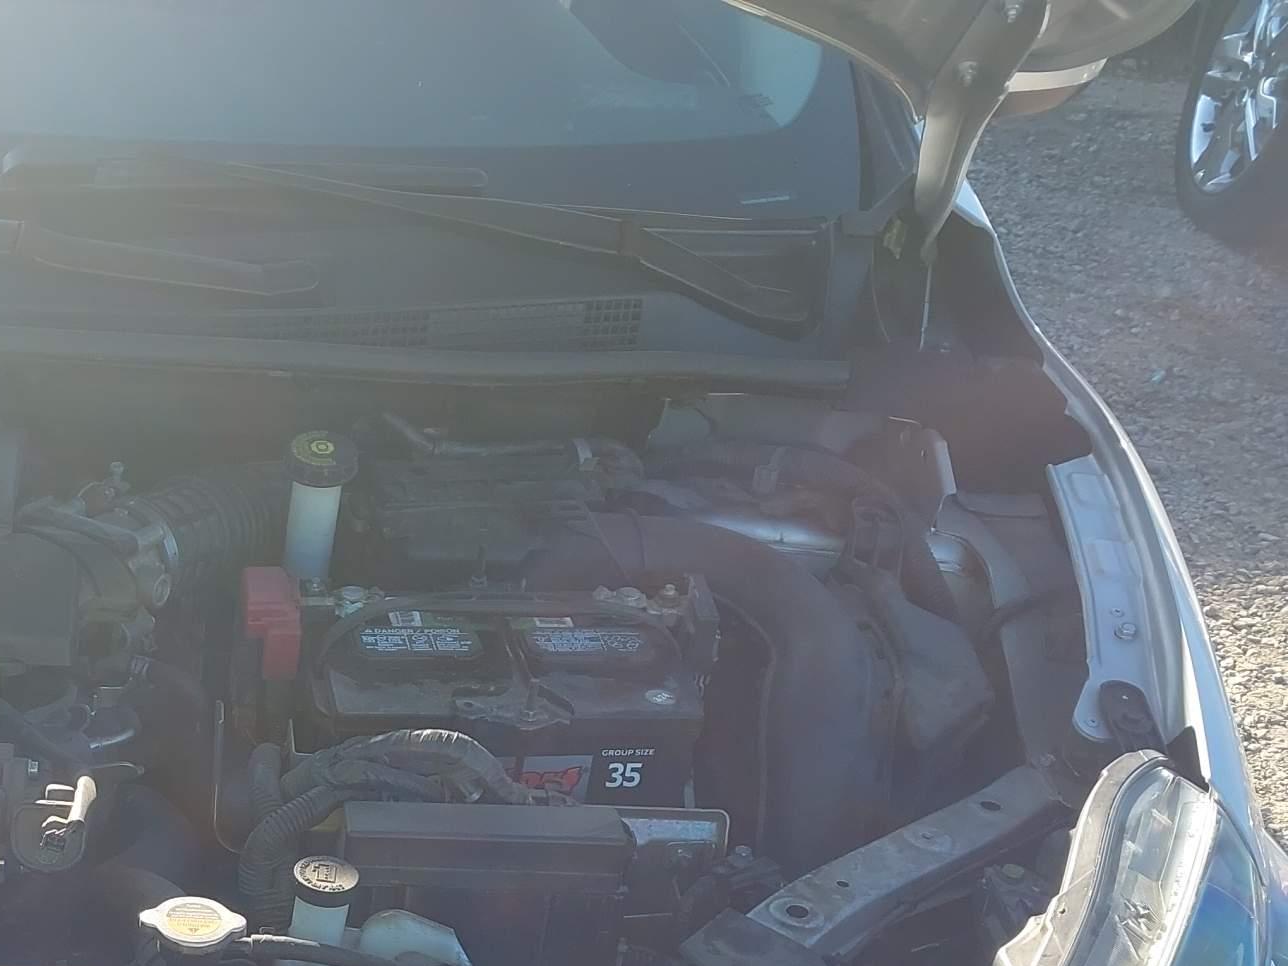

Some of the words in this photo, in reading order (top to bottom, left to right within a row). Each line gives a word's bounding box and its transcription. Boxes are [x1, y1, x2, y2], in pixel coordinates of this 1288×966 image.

[601, 749, 634, 757] GROUP
[635, 748, 656, 756] SIZE
[605, 762, 643, 788] 35
